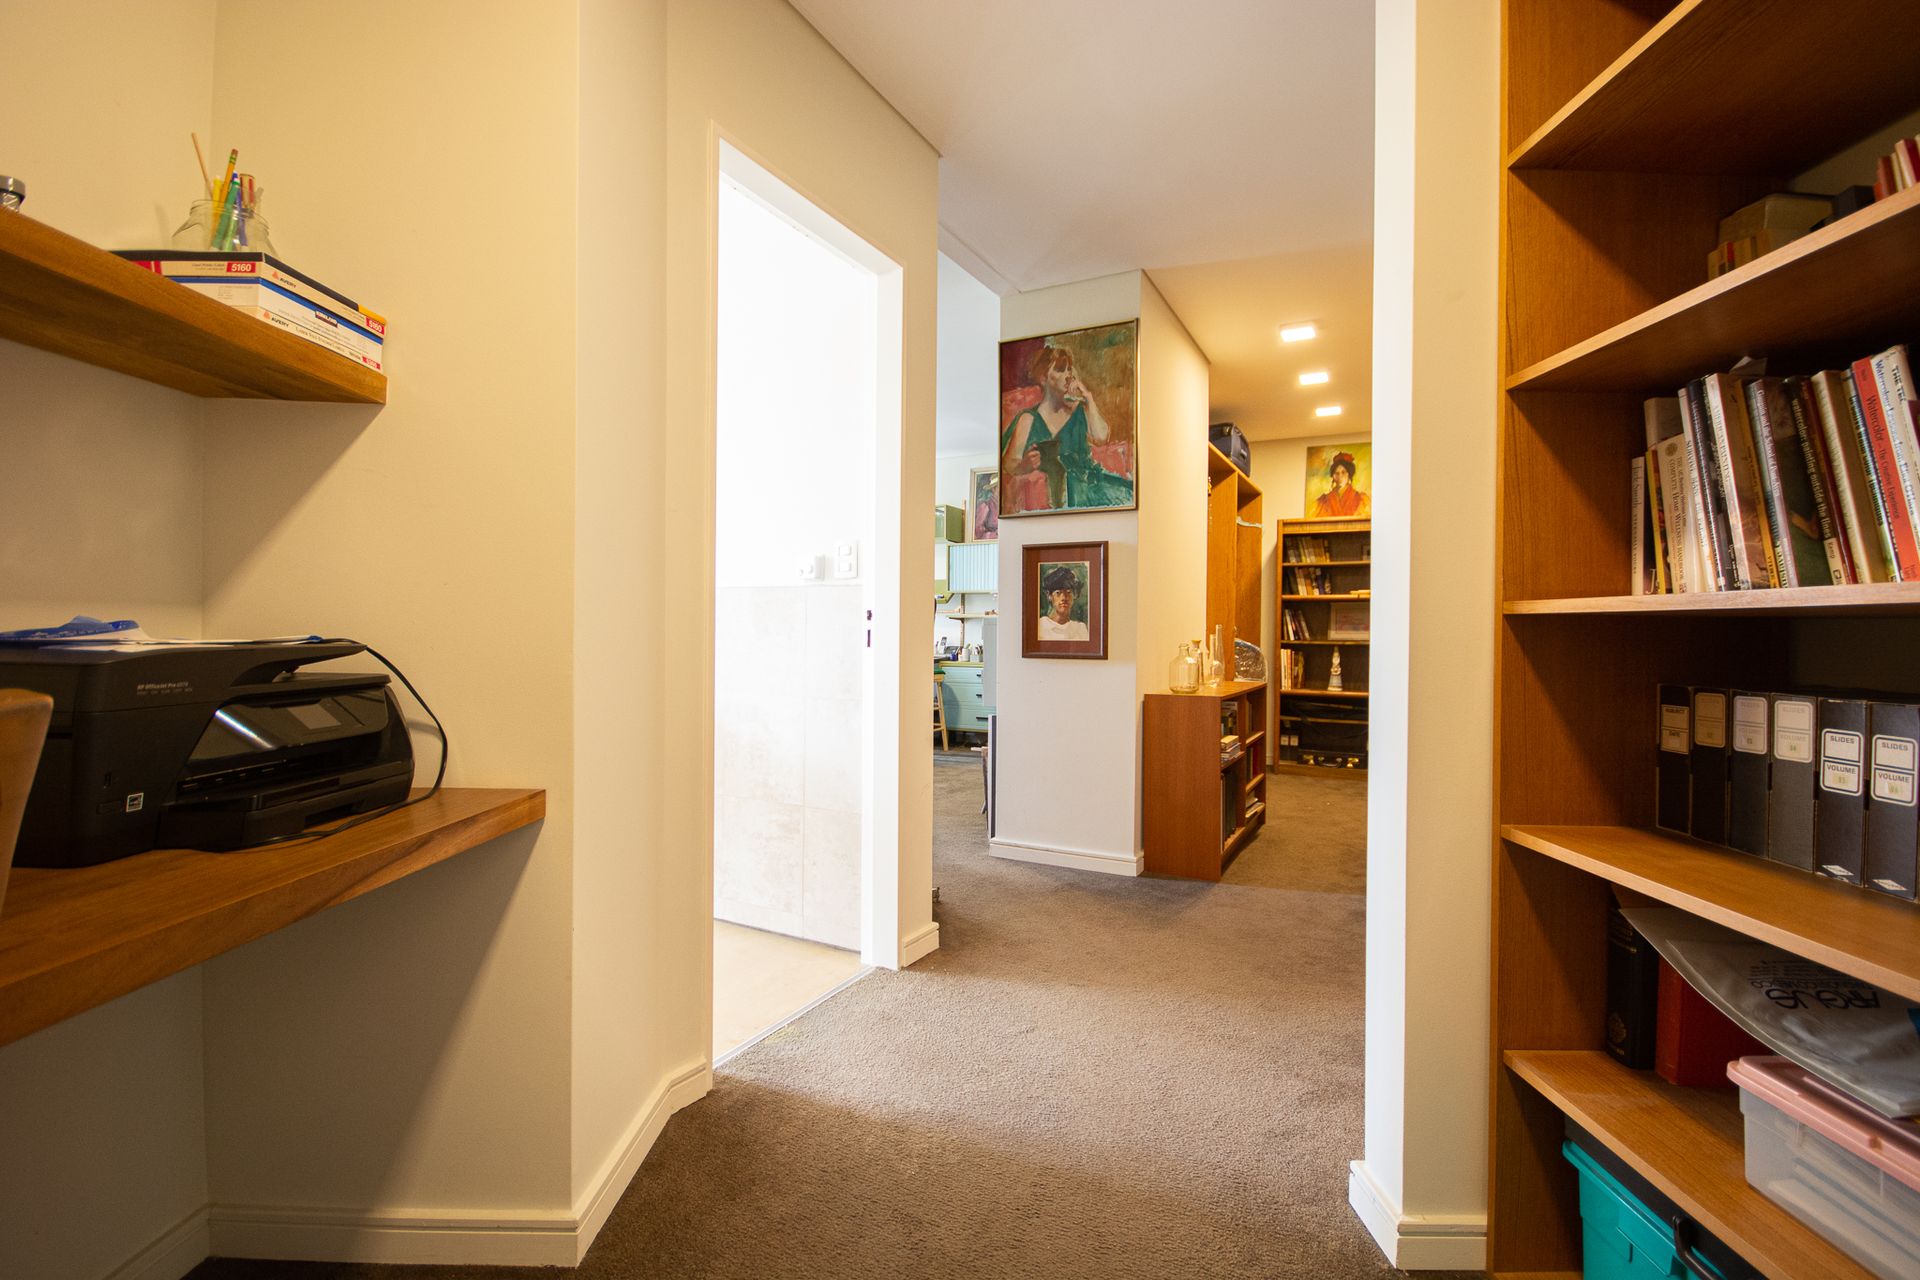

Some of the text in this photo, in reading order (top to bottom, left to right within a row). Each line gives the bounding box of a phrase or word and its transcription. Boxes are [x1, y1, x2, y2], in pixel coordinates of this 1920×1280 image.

[231, 263, 252, 272] 5160
[1792, 398, 1807, 441] watercolor:
[1867, 395, 1884, 441] Watercolor
[1801, 441, 1816, 473] painting
[1810, 474, 1824, 502] outside
[1817, 503, 1828, 518] the
[1821, 517, 1831, 538] lines
[1830, 735, 1855, 745] SLIDES
[1881, 742, 1909, 752] SLIDES
[1826, 763, 1857, 775] VOLUME
[1878, 772, 1911, 784] VOLUME
